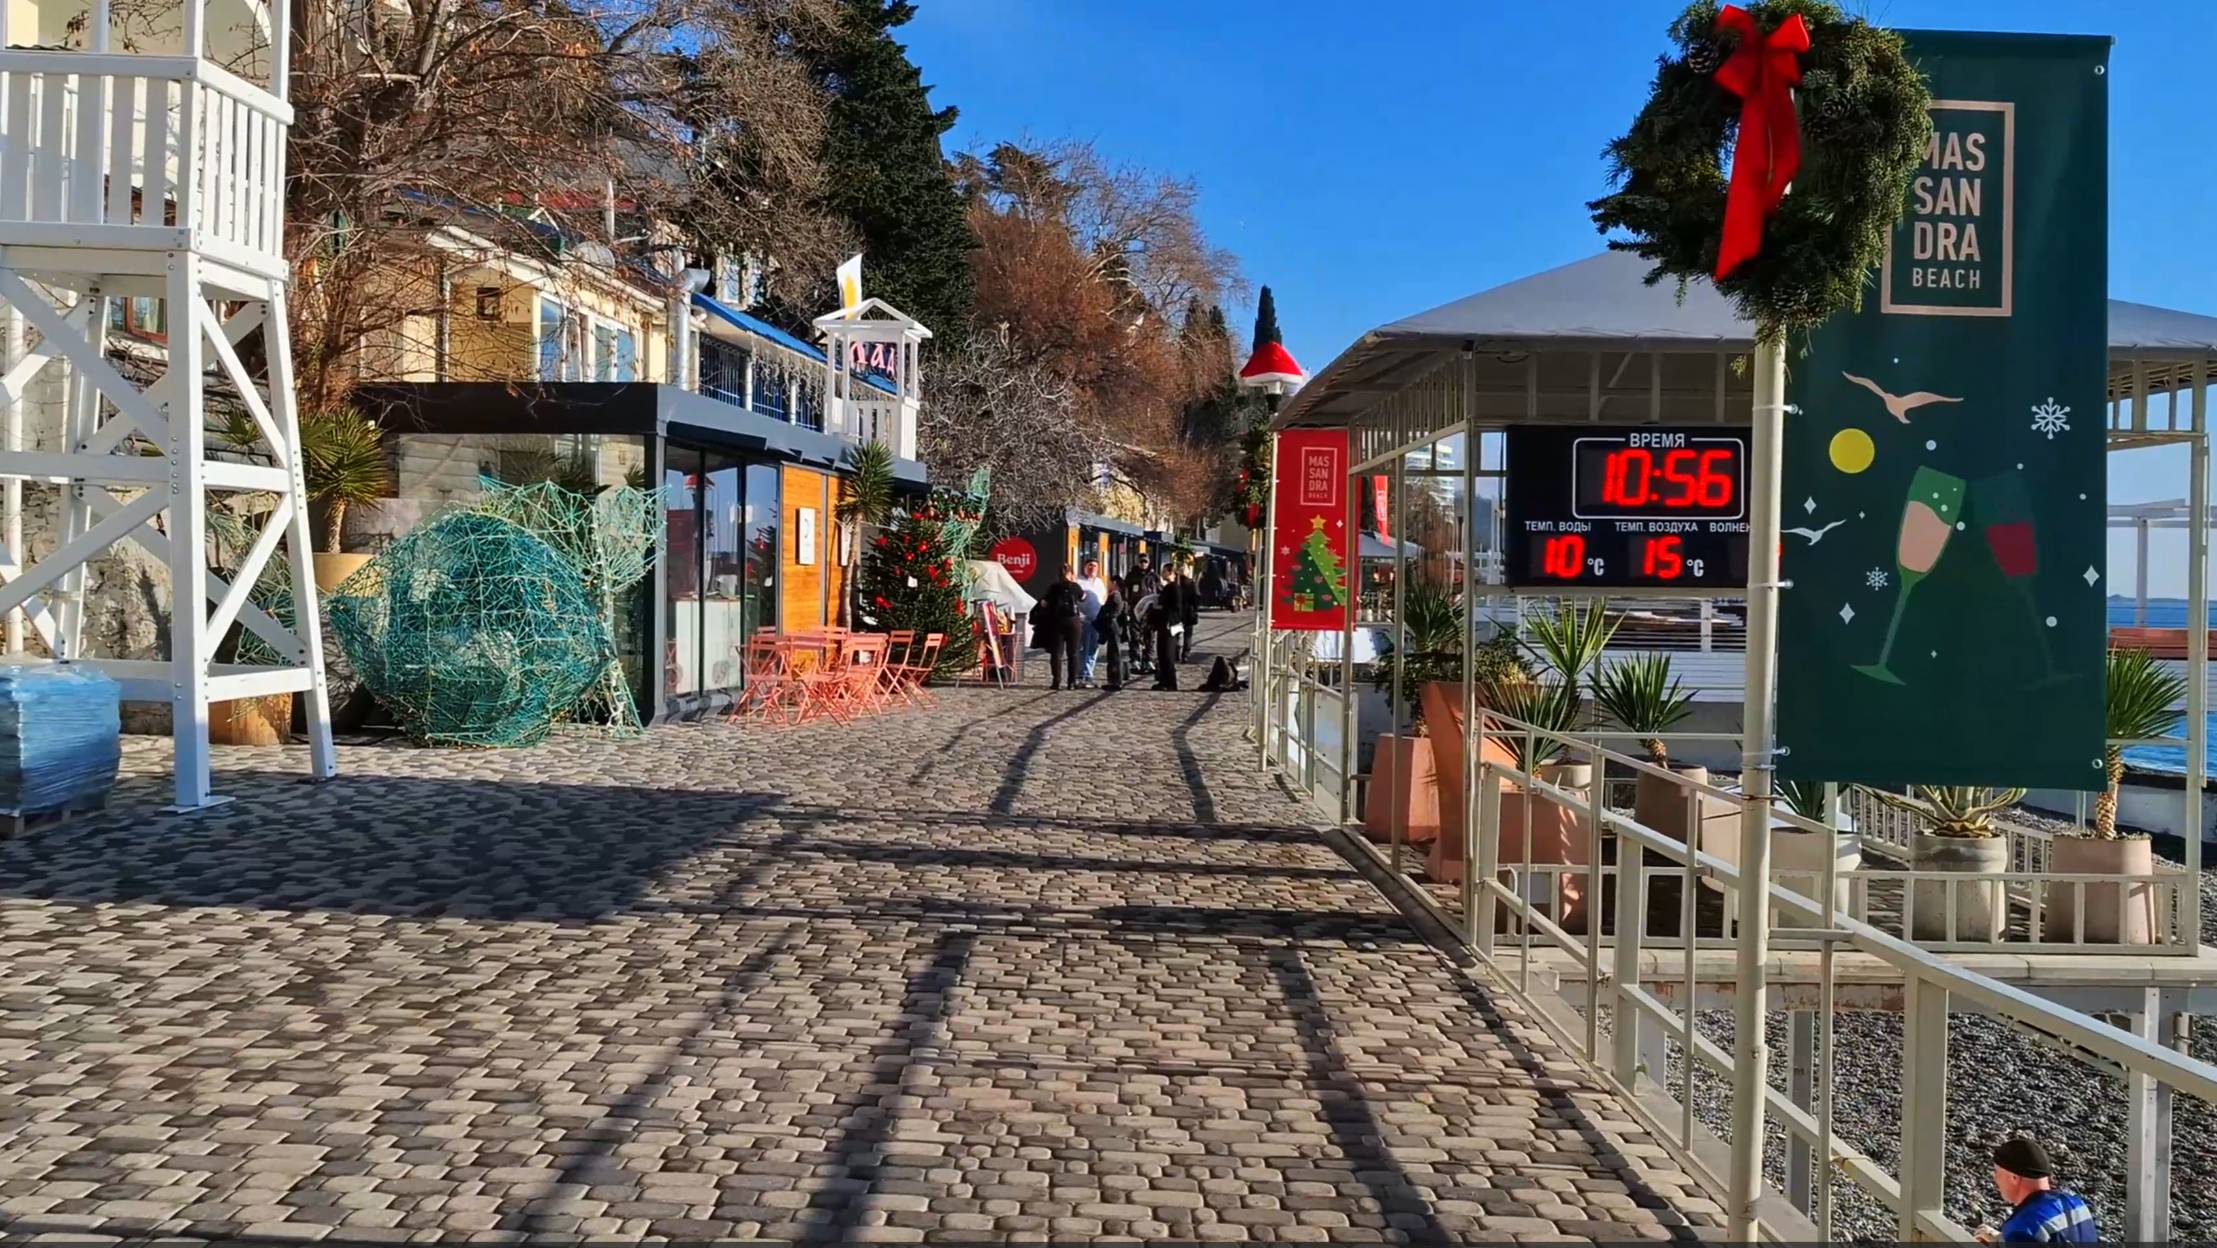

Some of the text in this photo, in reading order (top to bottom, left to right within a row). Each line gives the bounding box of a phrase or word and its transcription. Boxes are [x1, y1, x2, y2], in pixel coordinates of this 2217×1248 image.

[1913, 176, 1982, 216] SAN
[1913, 221, 1982, 262] DRA
[1912, 267, 1981, 289] BEACH
[1629, 433, 1685, 448] ВРЕМЯ
[1308, 455, 1330, 467] MAS
[1308, 467, 1329, 479] SAN
[1602, 448, 1733, 507] 10:56
[1308, 479, 1329, 491] DRA
[1524, 520, 1592, 533] ТЕМП. ВОДЫ
[1614, 521, 1699, 533] ТЕМП. ВОЗДУХА
[997, 553, 1030, 568] Benji
[1544, 535, 1585, 578] 10
[1643, 535, 1683, 578] 15
